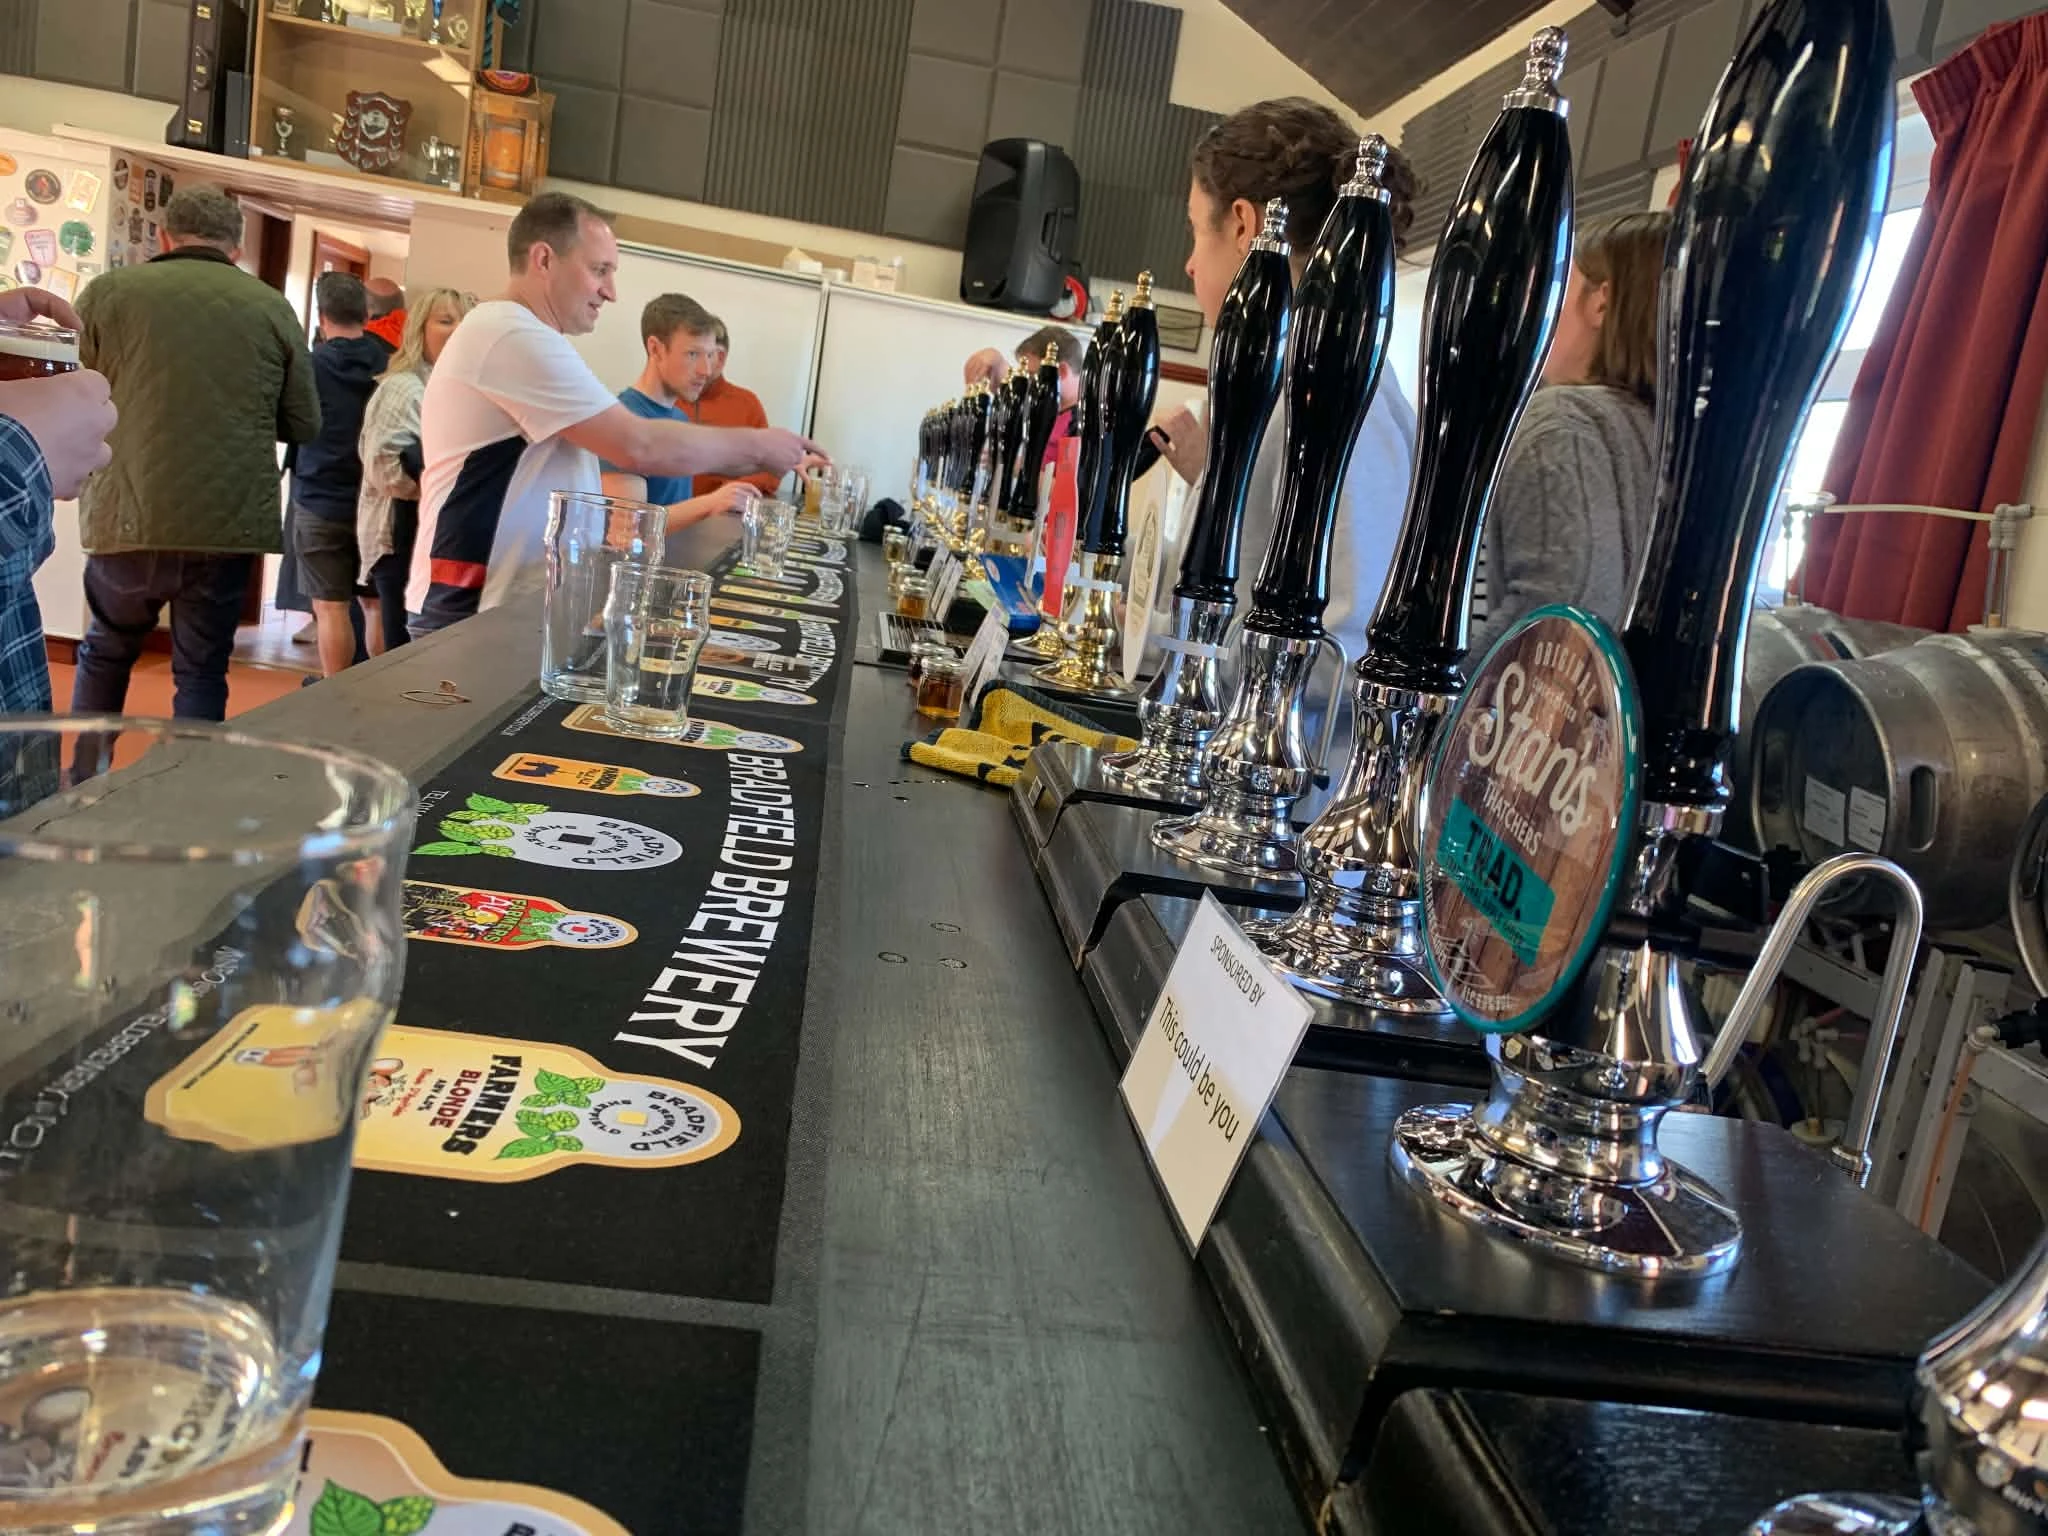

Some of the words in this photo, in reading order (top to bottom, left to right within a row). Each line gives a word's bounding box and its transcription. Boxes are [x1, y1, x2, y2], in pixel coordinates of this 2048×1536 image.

[1534, 640, 1598, 706] ORIGINAL
[1468, 661, 1597, 836] Stan's
[523, 825, 578, 851] SHEFFIELD
[571, 821, 665, 865] BRADFIELD
[587, 830, 630, 855] BREWERY
[719, 751, 796, 872] BRADFIELD
[1483, 777, 1542, 857] THATCHERS
[1463, 820, 1525, 922] TRAD.
[483, 898, 529, 945] FARMERS
[613, 870, 790, 1071] BREWERY
[1210, 934, 1253, 995] SPONSORED
[1247, 981, 1266, 1008] BY
[429, 1068, 483, 1129] BLONDE
[1158, 995, 1178, 1046] This
[1174, 1031, 1204, 1083] could
[1197, 1060, 1216, 1107] be
[1209, 1091, 1241, 1143] you
[442, 1054, 522, 1155] FARMERS
[588, 1099, 632, 1135] SHEFFIELD
[629, 1090, 706, 1152] BRADFIELD
[641, 1103, 676, 1137] BREWERY
